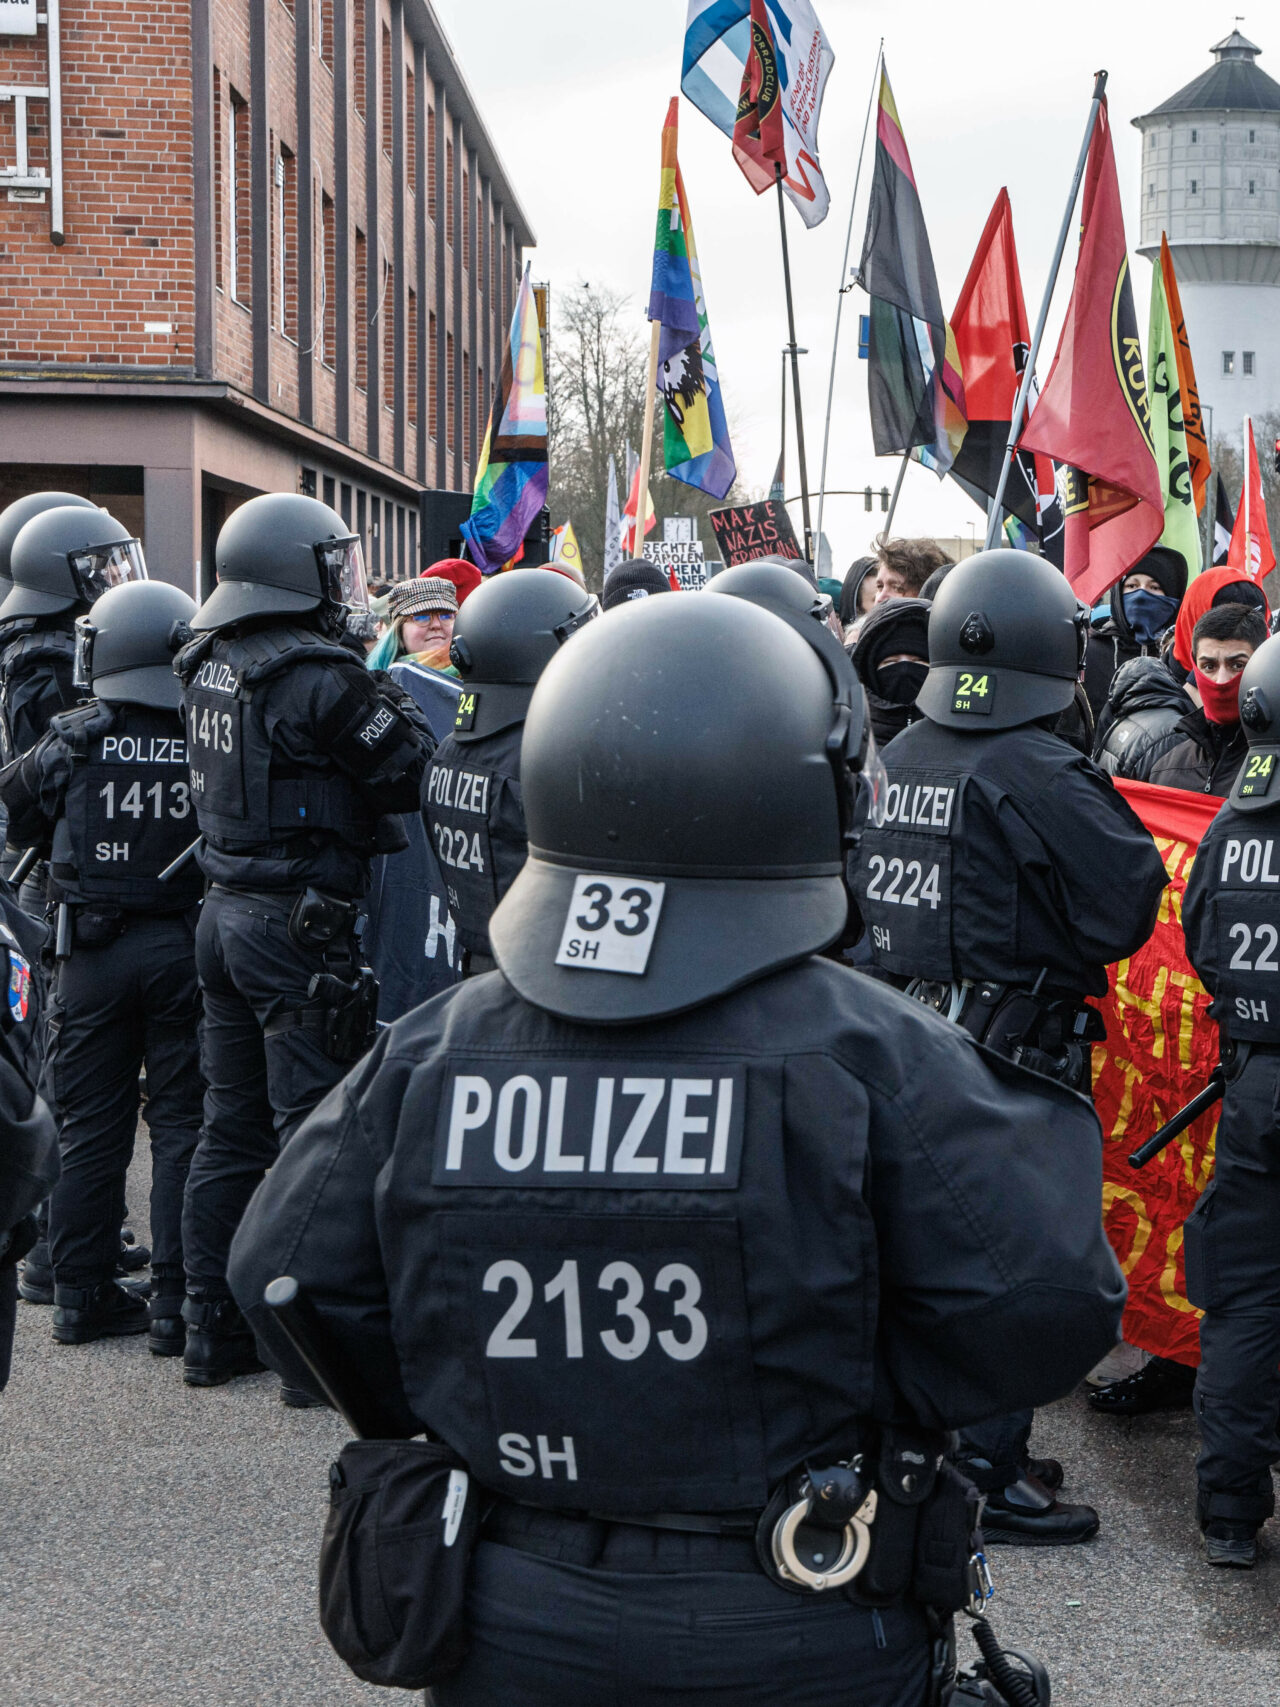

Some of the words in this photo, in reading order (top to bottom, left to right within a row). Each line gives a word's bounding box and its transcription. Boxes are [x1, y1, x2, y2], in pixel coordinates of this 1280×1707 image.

[711, 501, 776, 532] MAKE
[642, 542, 697, 553] RECHTE
[724, 520, 779, 551] NAZIS
[956, 673, 989, 698] 24
[458, 694, 475, 715] 24
[955, 700, 970, 709] SH
[190, 705, 233, 754] 1413
[360, 707, 394, 746] POLIZEI
[191, 769, 204, 792] SH
[1245, 754, 1273, 778] 24
[99, 781, 191, 819] 1413
[428, 765, 490, 815] POLIZEI
[1242, 784, 1254, 794] SH
[95, 842, 129, 861] SH
[434, 822, 485, 873] 2224
[867, 854, 942, 910] 2224
[576, 883, 653, 936] 33
[566, 939, 600, 960] SH
[873, 925, 891, 951] SH
[1235, 997, 1269, 1022] SH
[445, 1074, 733, 1174] POLIZEI
[482, 1259, 708, 1361] 2133
[498, 1432, 578, 1480] SH
